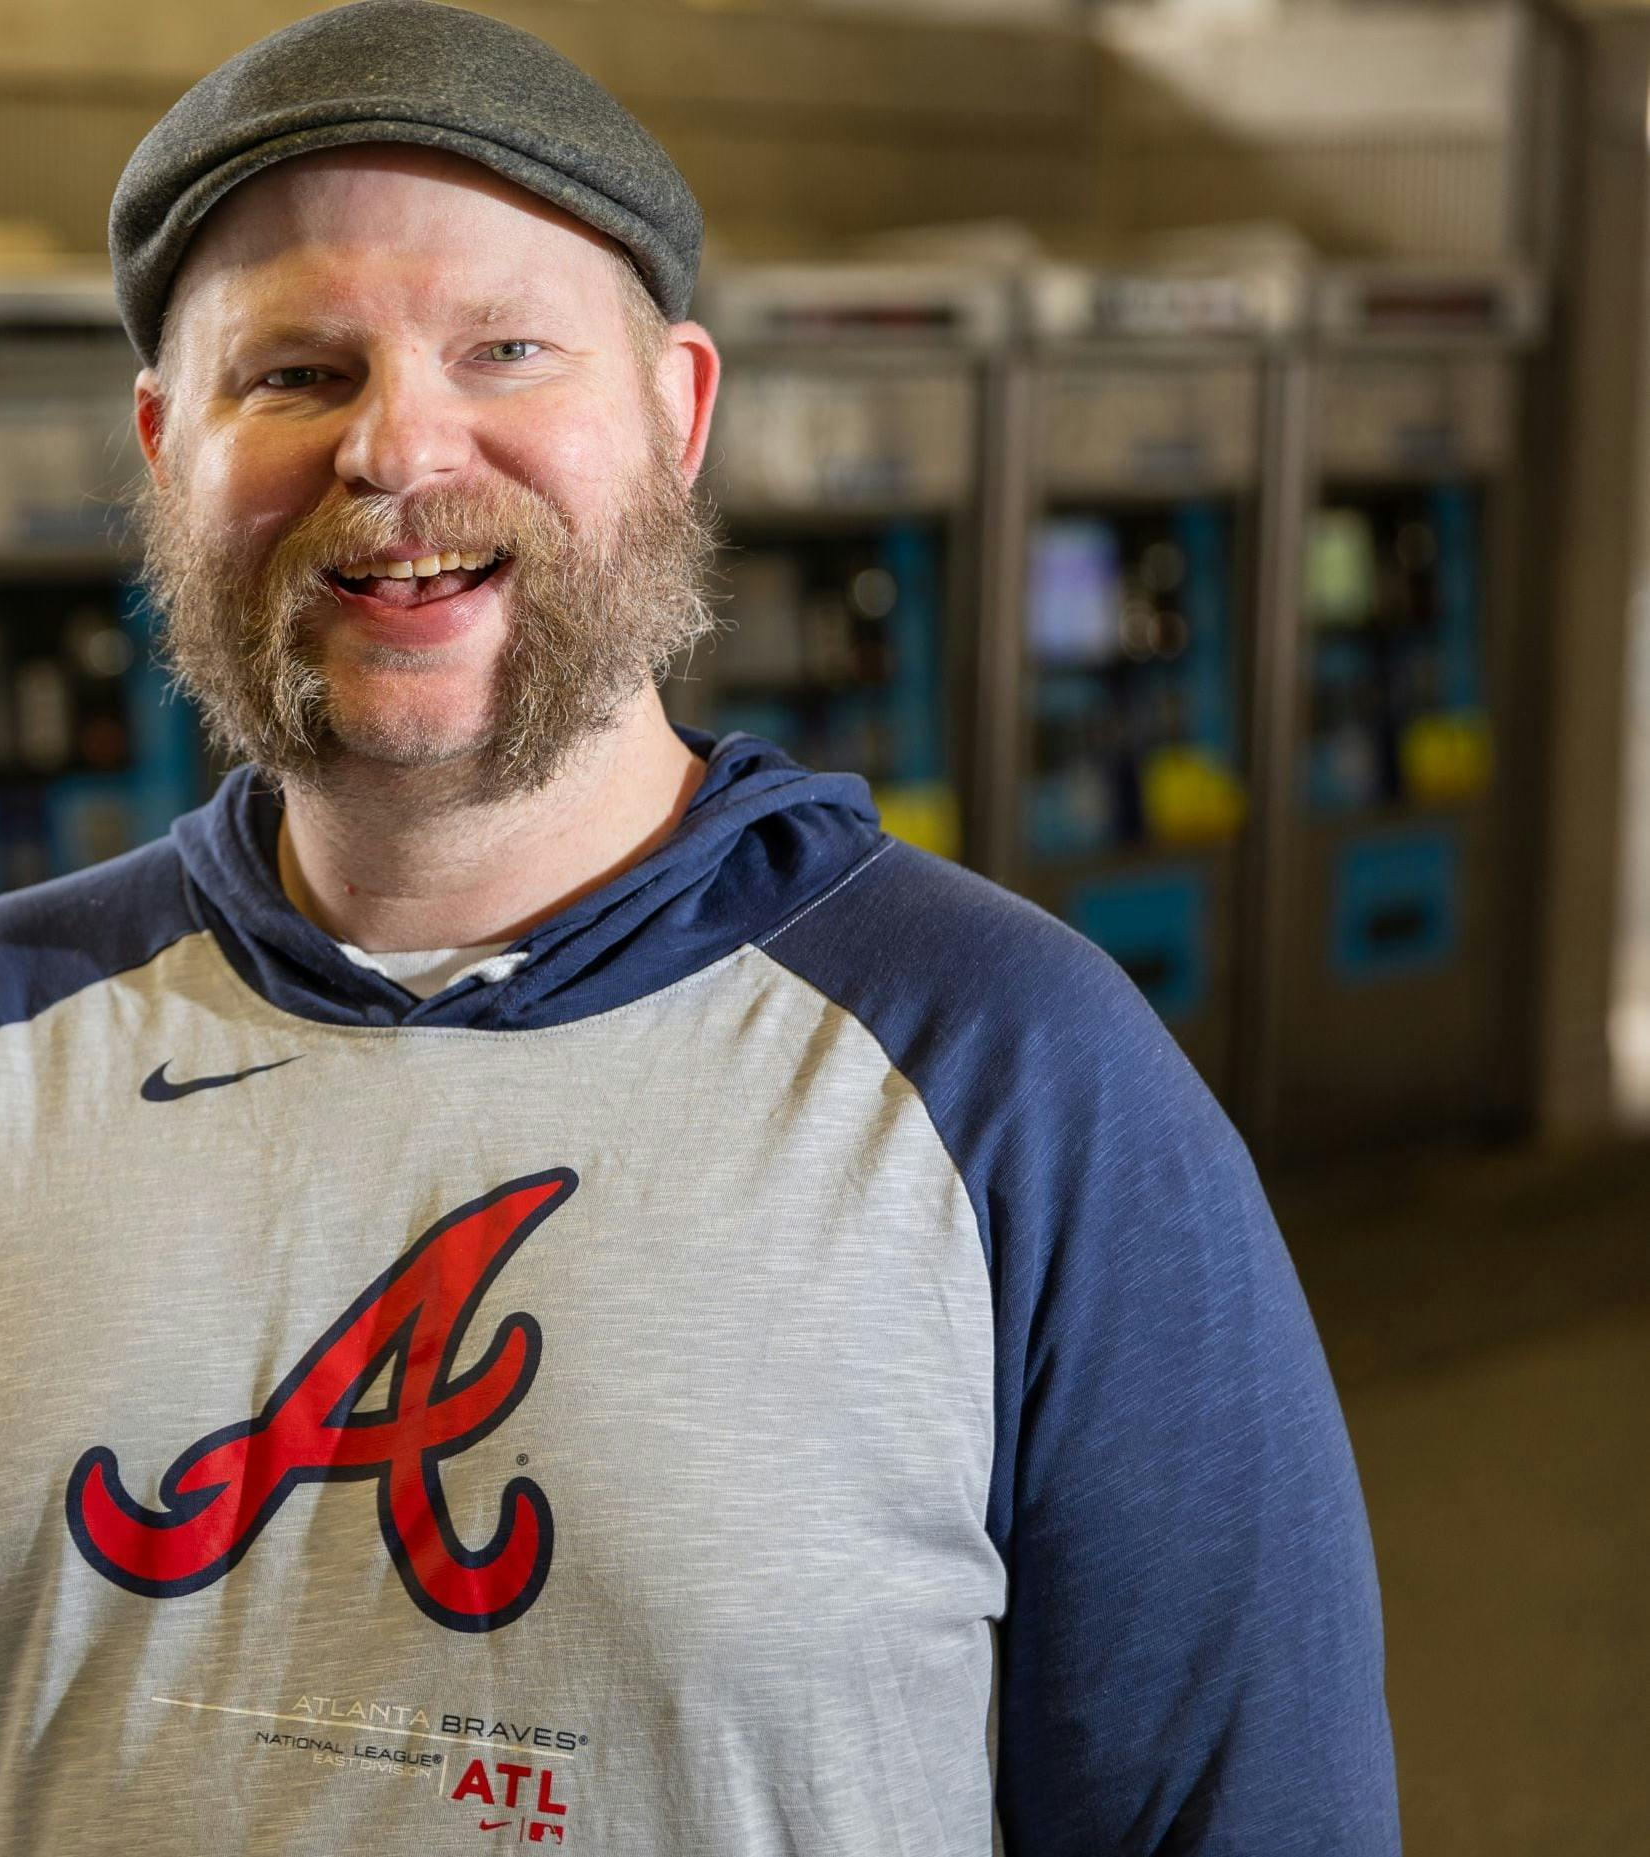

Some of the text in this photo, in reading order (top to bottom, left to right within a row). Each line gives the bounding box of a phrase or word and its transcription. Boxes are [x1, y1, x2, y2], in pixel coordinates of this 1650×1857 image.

[65, 1166, 579, 1633] A
[291, 1695, 431, 1728] ATLANTA
[255, 1731, 344, 1754] NATIONAL
[312, 1753, 432, 1779] EAST DIVISION
[451, 1758, 568, 1816] ATL
